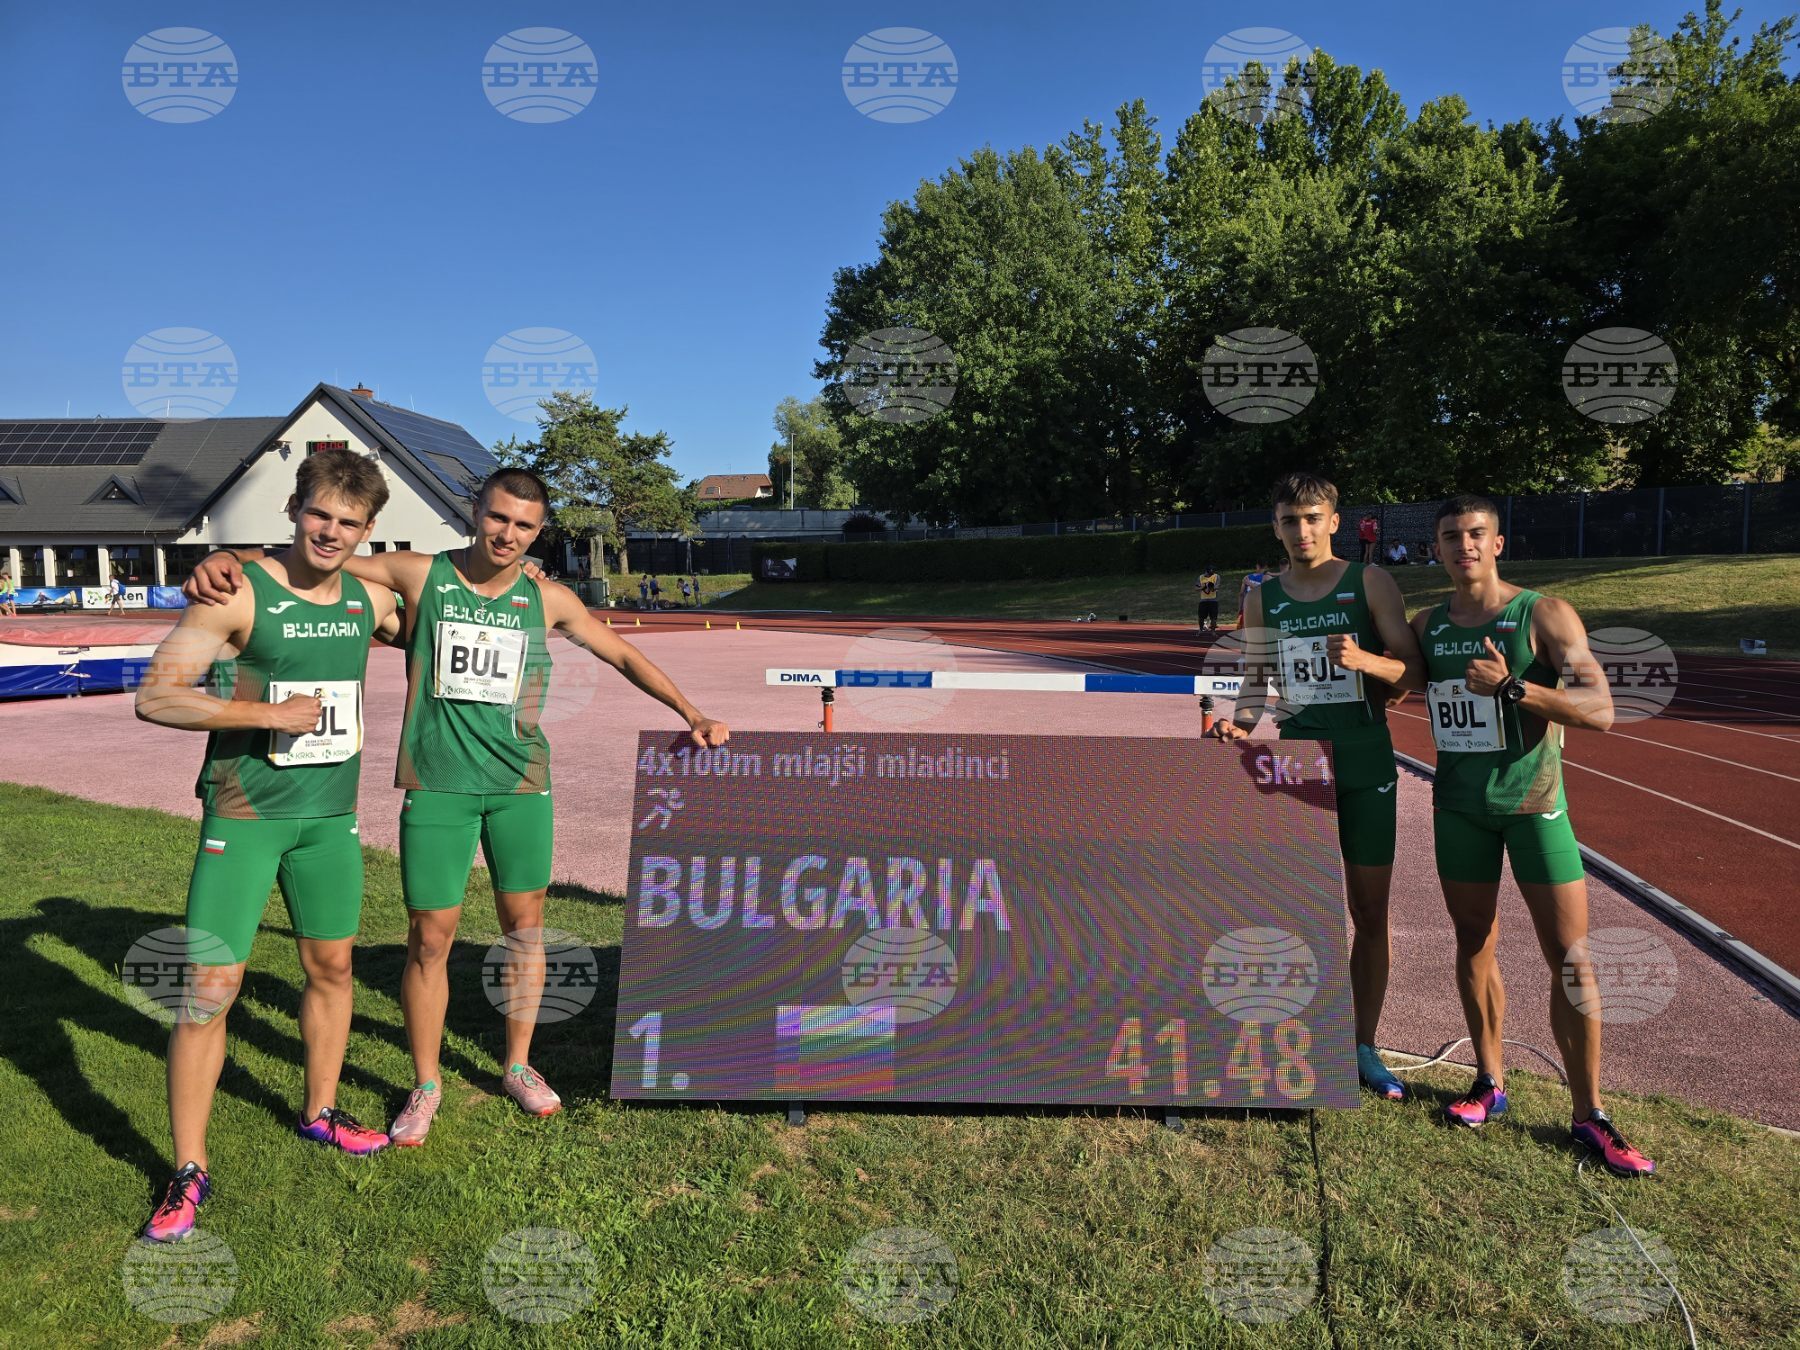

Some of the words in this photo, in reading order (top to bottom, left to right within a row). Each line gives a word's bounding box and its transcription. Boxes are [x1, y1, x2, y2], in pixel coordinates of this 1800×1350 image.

[283, 622, 360, 638] BULGARIA
[443, 604, 521, 628] BULGARIA
[1280, 611, 1350, 633] BULGARIA
[450, 645, 508, 680] BUL
[1434, 641, 1507, 657] BULGAA
[780, 673, 822, 682] DIMA
[1293, 656, 1347, 683] BUL
[1212, 681, 1241, 691] DIM
[290, 706, 348, 737] UL
[1438, 700, 1487, 729] BUL
[637, 745, 762, 776] 4x100m
[772, 745, 866, 788] mlajši
[876, 747, 1010, 780] mladinci
[1255, 754, 1304, 785] SK:
[1314, 755, 1331, 785] 1
[637, 854, 1012, 932] BULGARIA
[628, 1010, 690, 1090] 1.
[1105, 1018, 1316, 1098] 41.48
